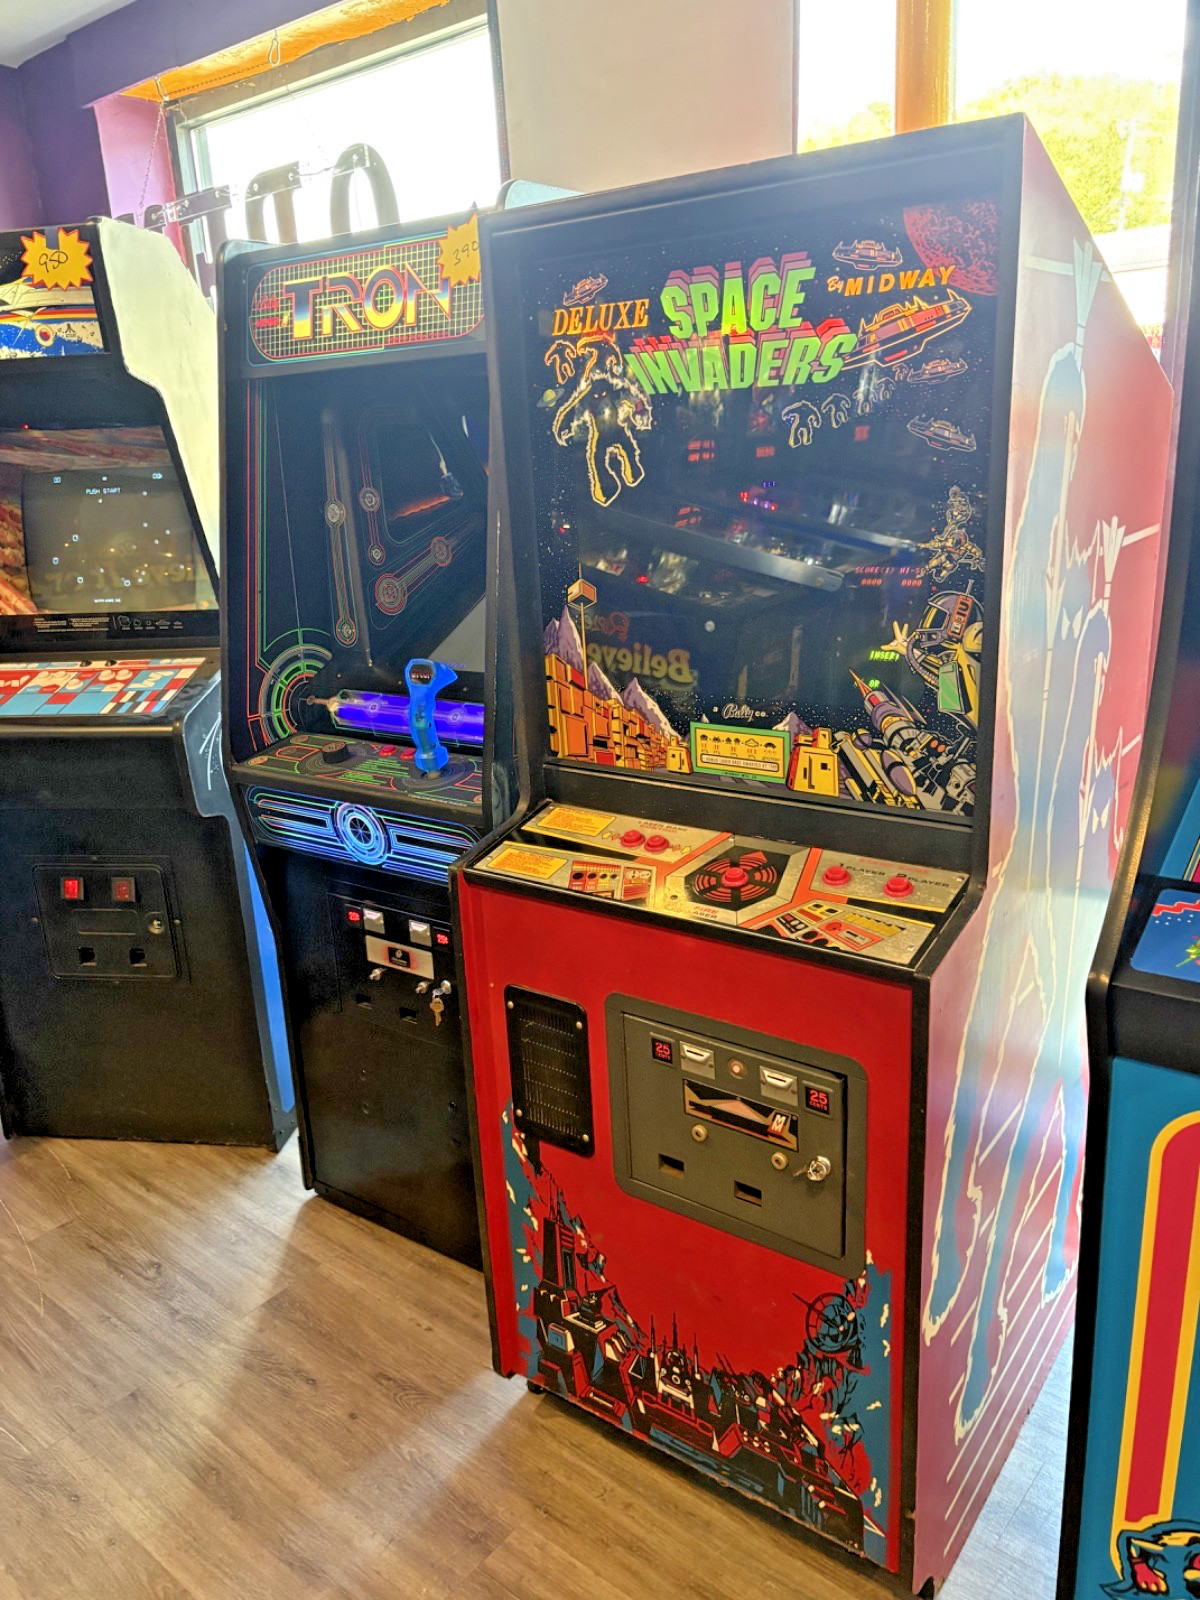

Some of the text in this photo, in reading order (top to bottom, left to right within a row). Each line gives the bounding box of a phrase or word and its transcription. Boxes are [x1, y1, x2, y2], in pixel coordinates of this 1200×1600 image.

[826, 265, 956, 297] By MIDWAY
[281, 261, 452, 341] TRON
[660, 254, 817, 340] SPACE
[551, 298, 650, 337] DELUXE
[623, 325, 859, 395] INVADERS
[102, 486, 121, 495] START
[723, 703, 754, 722] Bally
[846, 865, 886, 877] PLAYER
[908, 876, 950, 888] PLAYER
[655, 1041, 670, 1055] 25
[808, 1088, 828, 1105] 25
[808, 1100, 828, 1111] CENTS
